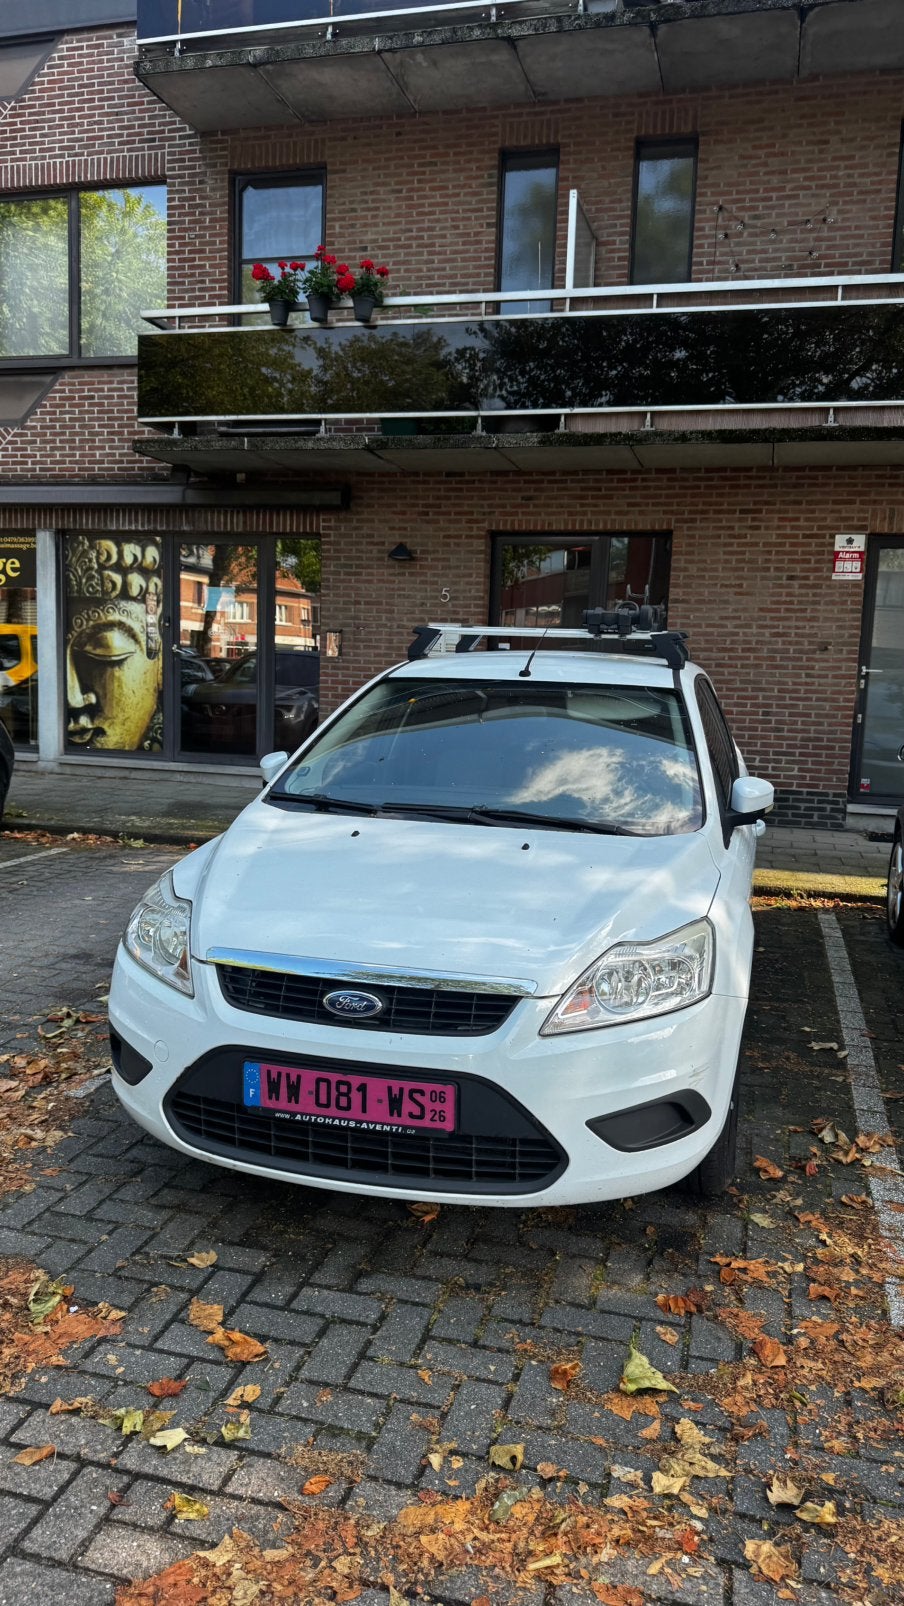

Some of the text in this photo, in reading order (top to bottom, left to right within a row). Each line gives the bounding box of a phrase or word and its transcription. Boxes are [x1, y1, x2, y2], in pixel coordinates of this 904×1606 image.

[440, 587, 450, 603] 5
[335, 995, 367, 1011] Ford
[249, 1088, 256, 1098] F
[429, 1090, 447, 1104] 06
[429, 1109, 447, 1123] 26
